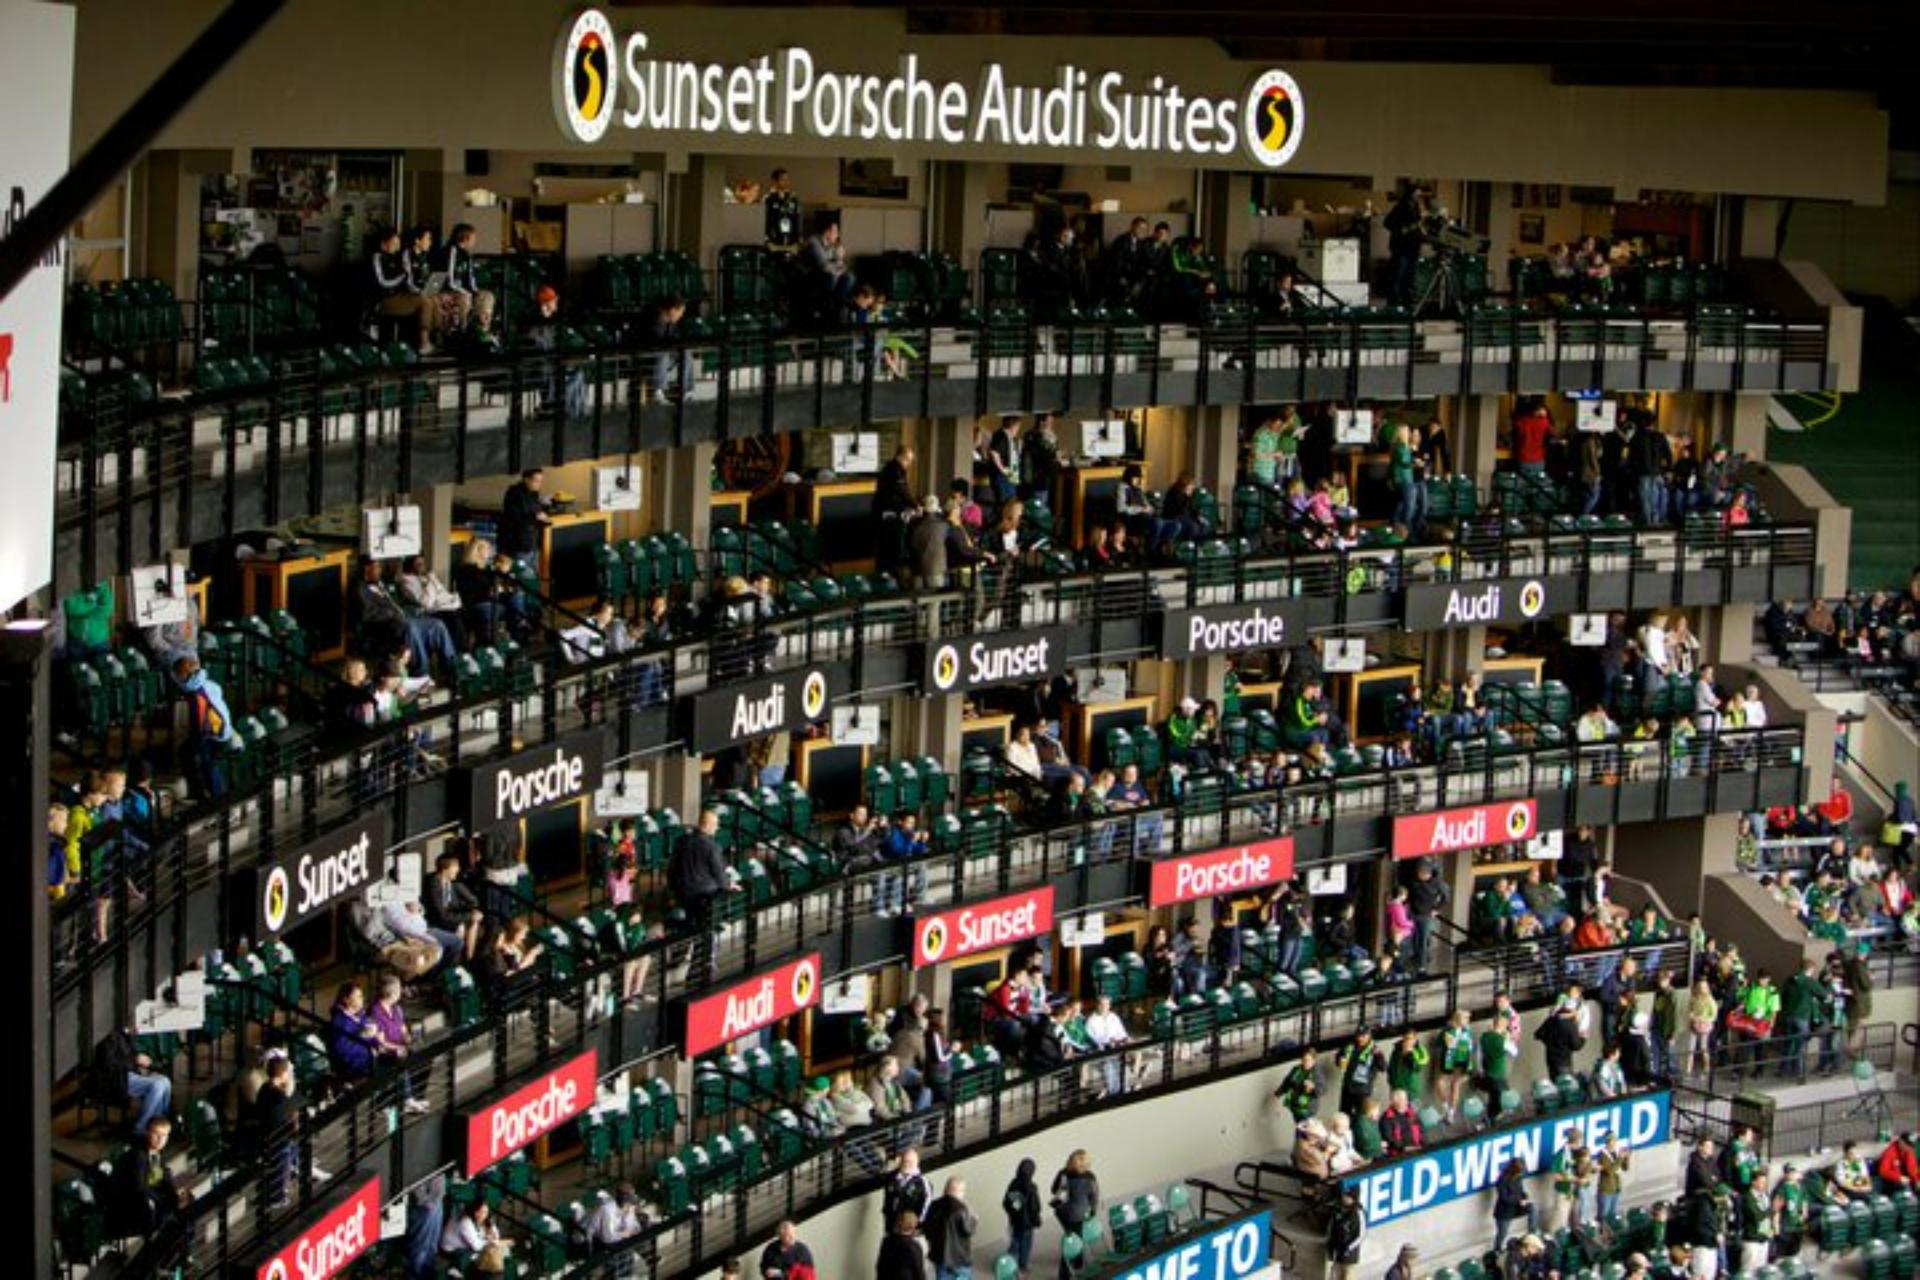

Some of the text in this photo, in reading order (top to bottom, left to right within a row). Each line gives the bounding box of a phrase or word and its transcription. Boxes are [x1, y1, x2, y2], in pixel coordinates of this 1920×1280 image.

[623, 32, 775, 136] Sunset
[785, 47, 968, 143] Porsche
[975, 64, 1086, 147] Audi
[1097, 72, 1238, 154] Suites
[1189, 607, 1284, 652] Porsche
[1444, 585, 1500, 623] Audi
[969, 637, 1049, 683] Sunset
[731, 684, 786, 738] Audi
[496, 748, 583, 818] Porsche
[1430, 808, 1487, 850] Audi
[297, 832, 370, 914] Sunset
[1175, 847, 1271, 898] Porsche
[956, 899, 1037, 952] Sunset
[721, 979, 775, 1038] Audi
[490, 1075, 578, 1158] Porsche
[1554, 1100, 1659, 1155] FIELD
[296, 1200, 367, 1280] Sunset
[1212, 1221, 1259, 1280] TO
